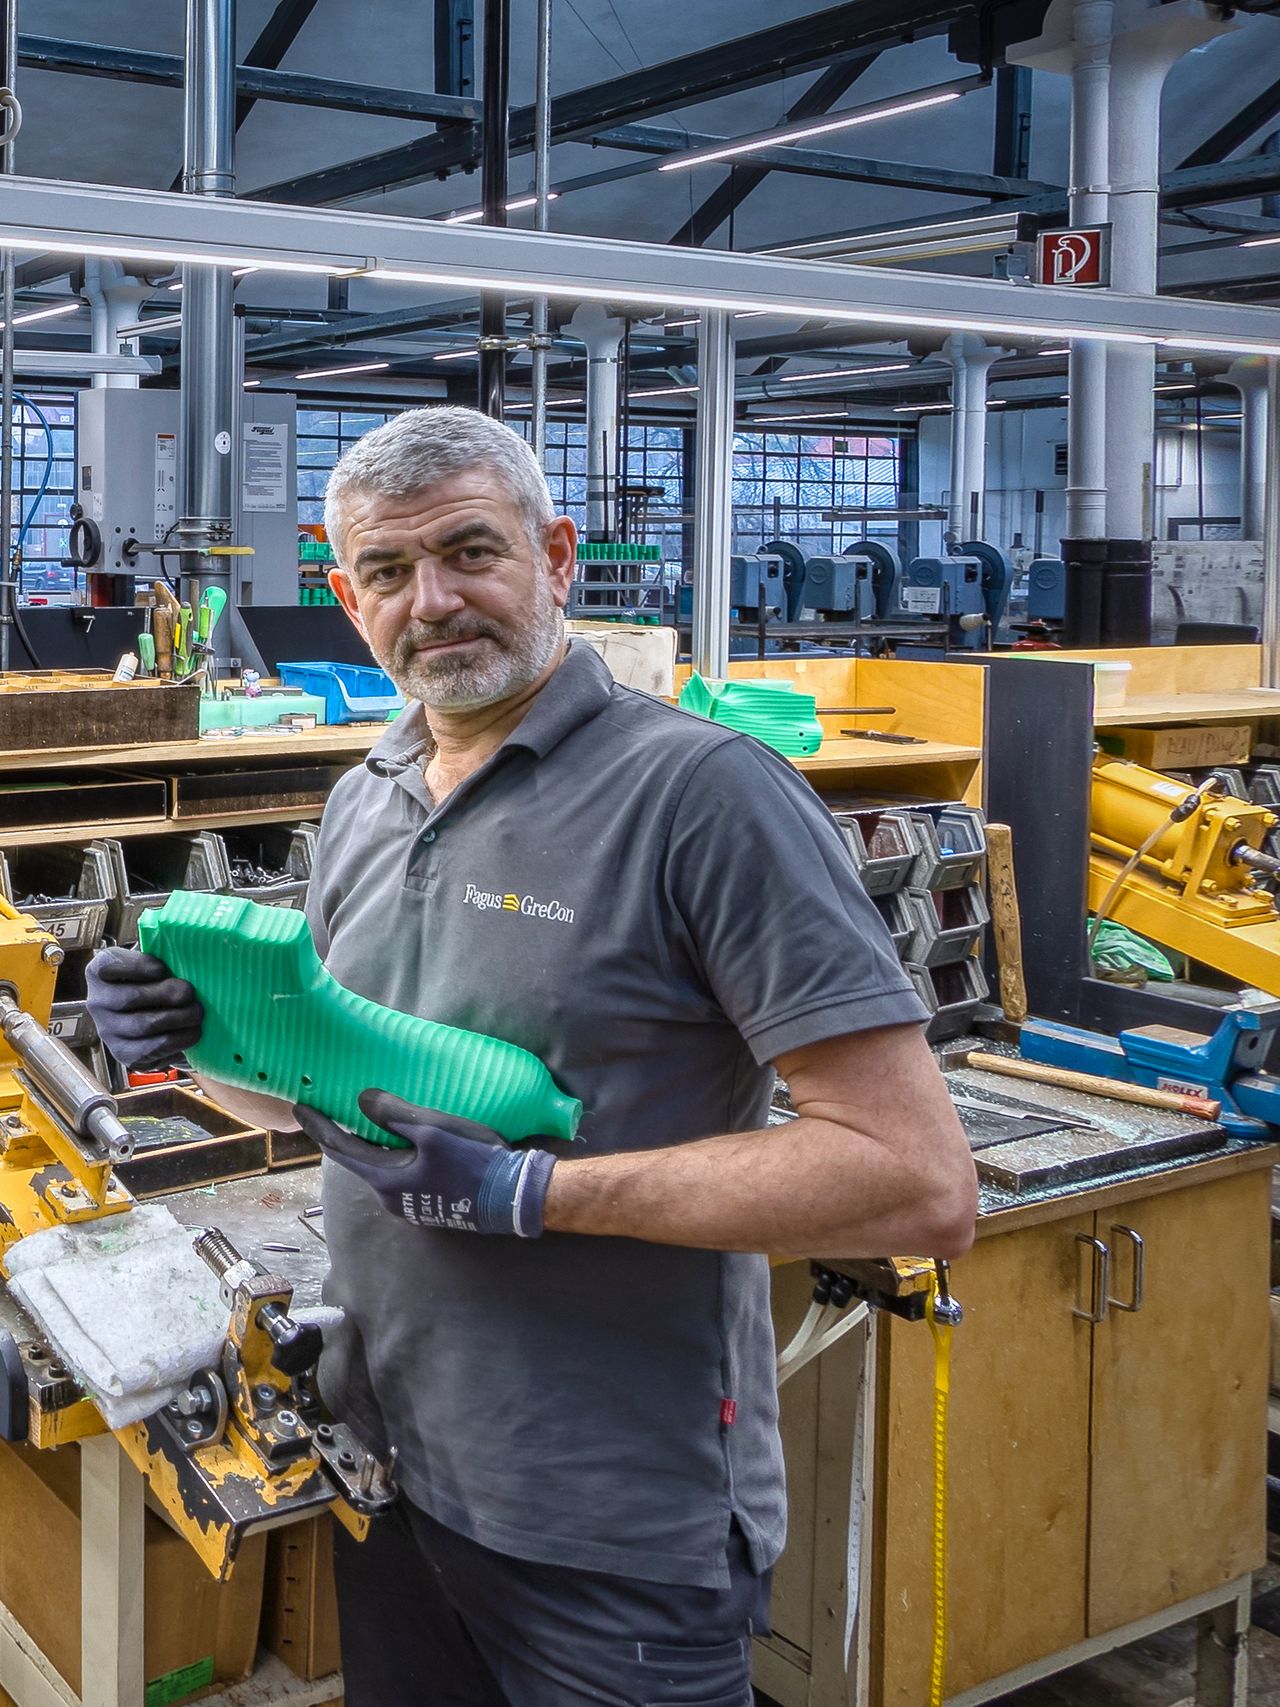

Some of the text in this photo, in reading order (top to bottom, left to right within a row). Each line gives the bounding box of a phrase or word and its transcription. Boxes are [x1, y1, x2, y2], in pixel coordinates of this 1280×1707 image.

[463, 884, 575, 924] Fagus GreCon
[48, 923, 65, 937] 45
